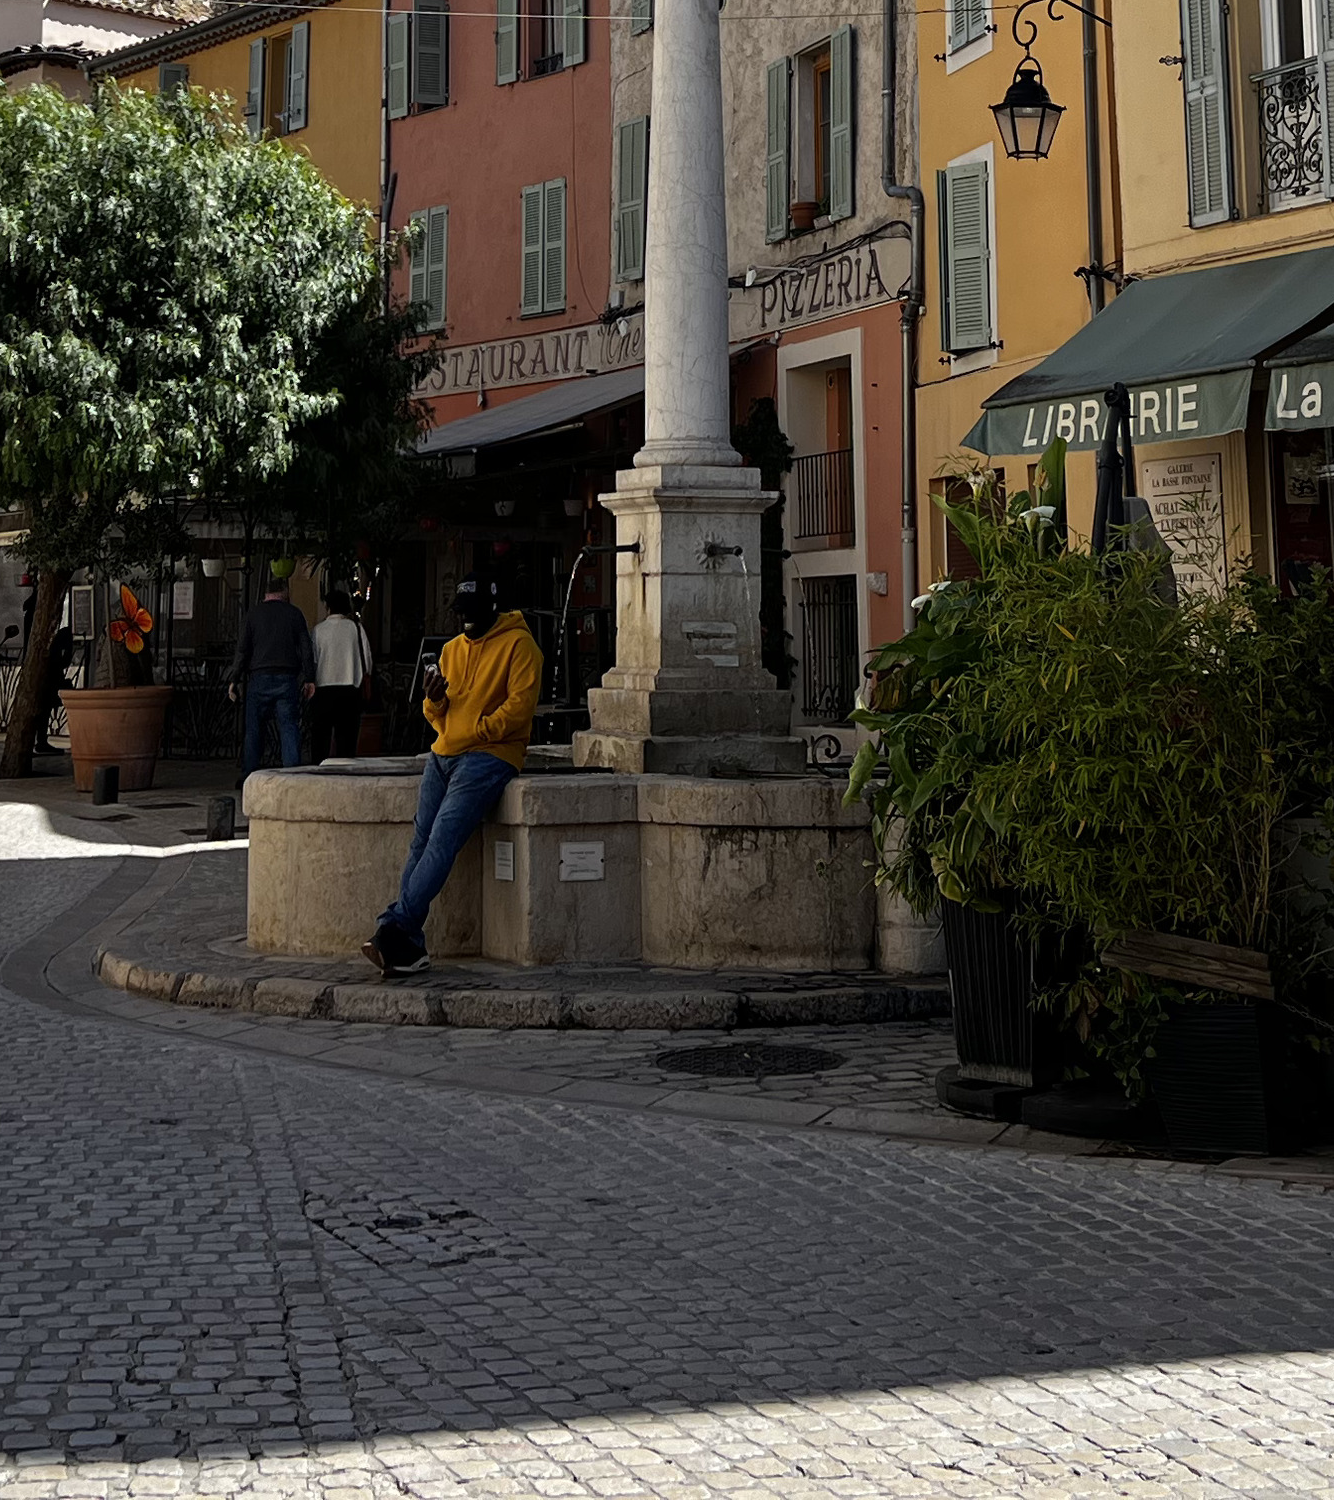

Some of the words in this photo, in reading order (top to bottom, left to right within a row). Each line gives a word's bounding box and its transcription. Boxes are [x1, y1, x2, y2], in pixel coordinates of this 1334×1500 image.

[415, 330, 590, 394] STAURANT
[1275, 373, 1323, 420] La
[1151, 478, 1160, 488] LA
[1162, 476, 1180, 487] BASSE
[1181, 473, 1212, 485] FONTAINE
[1167, 463, 1194, 475] GALERIE
